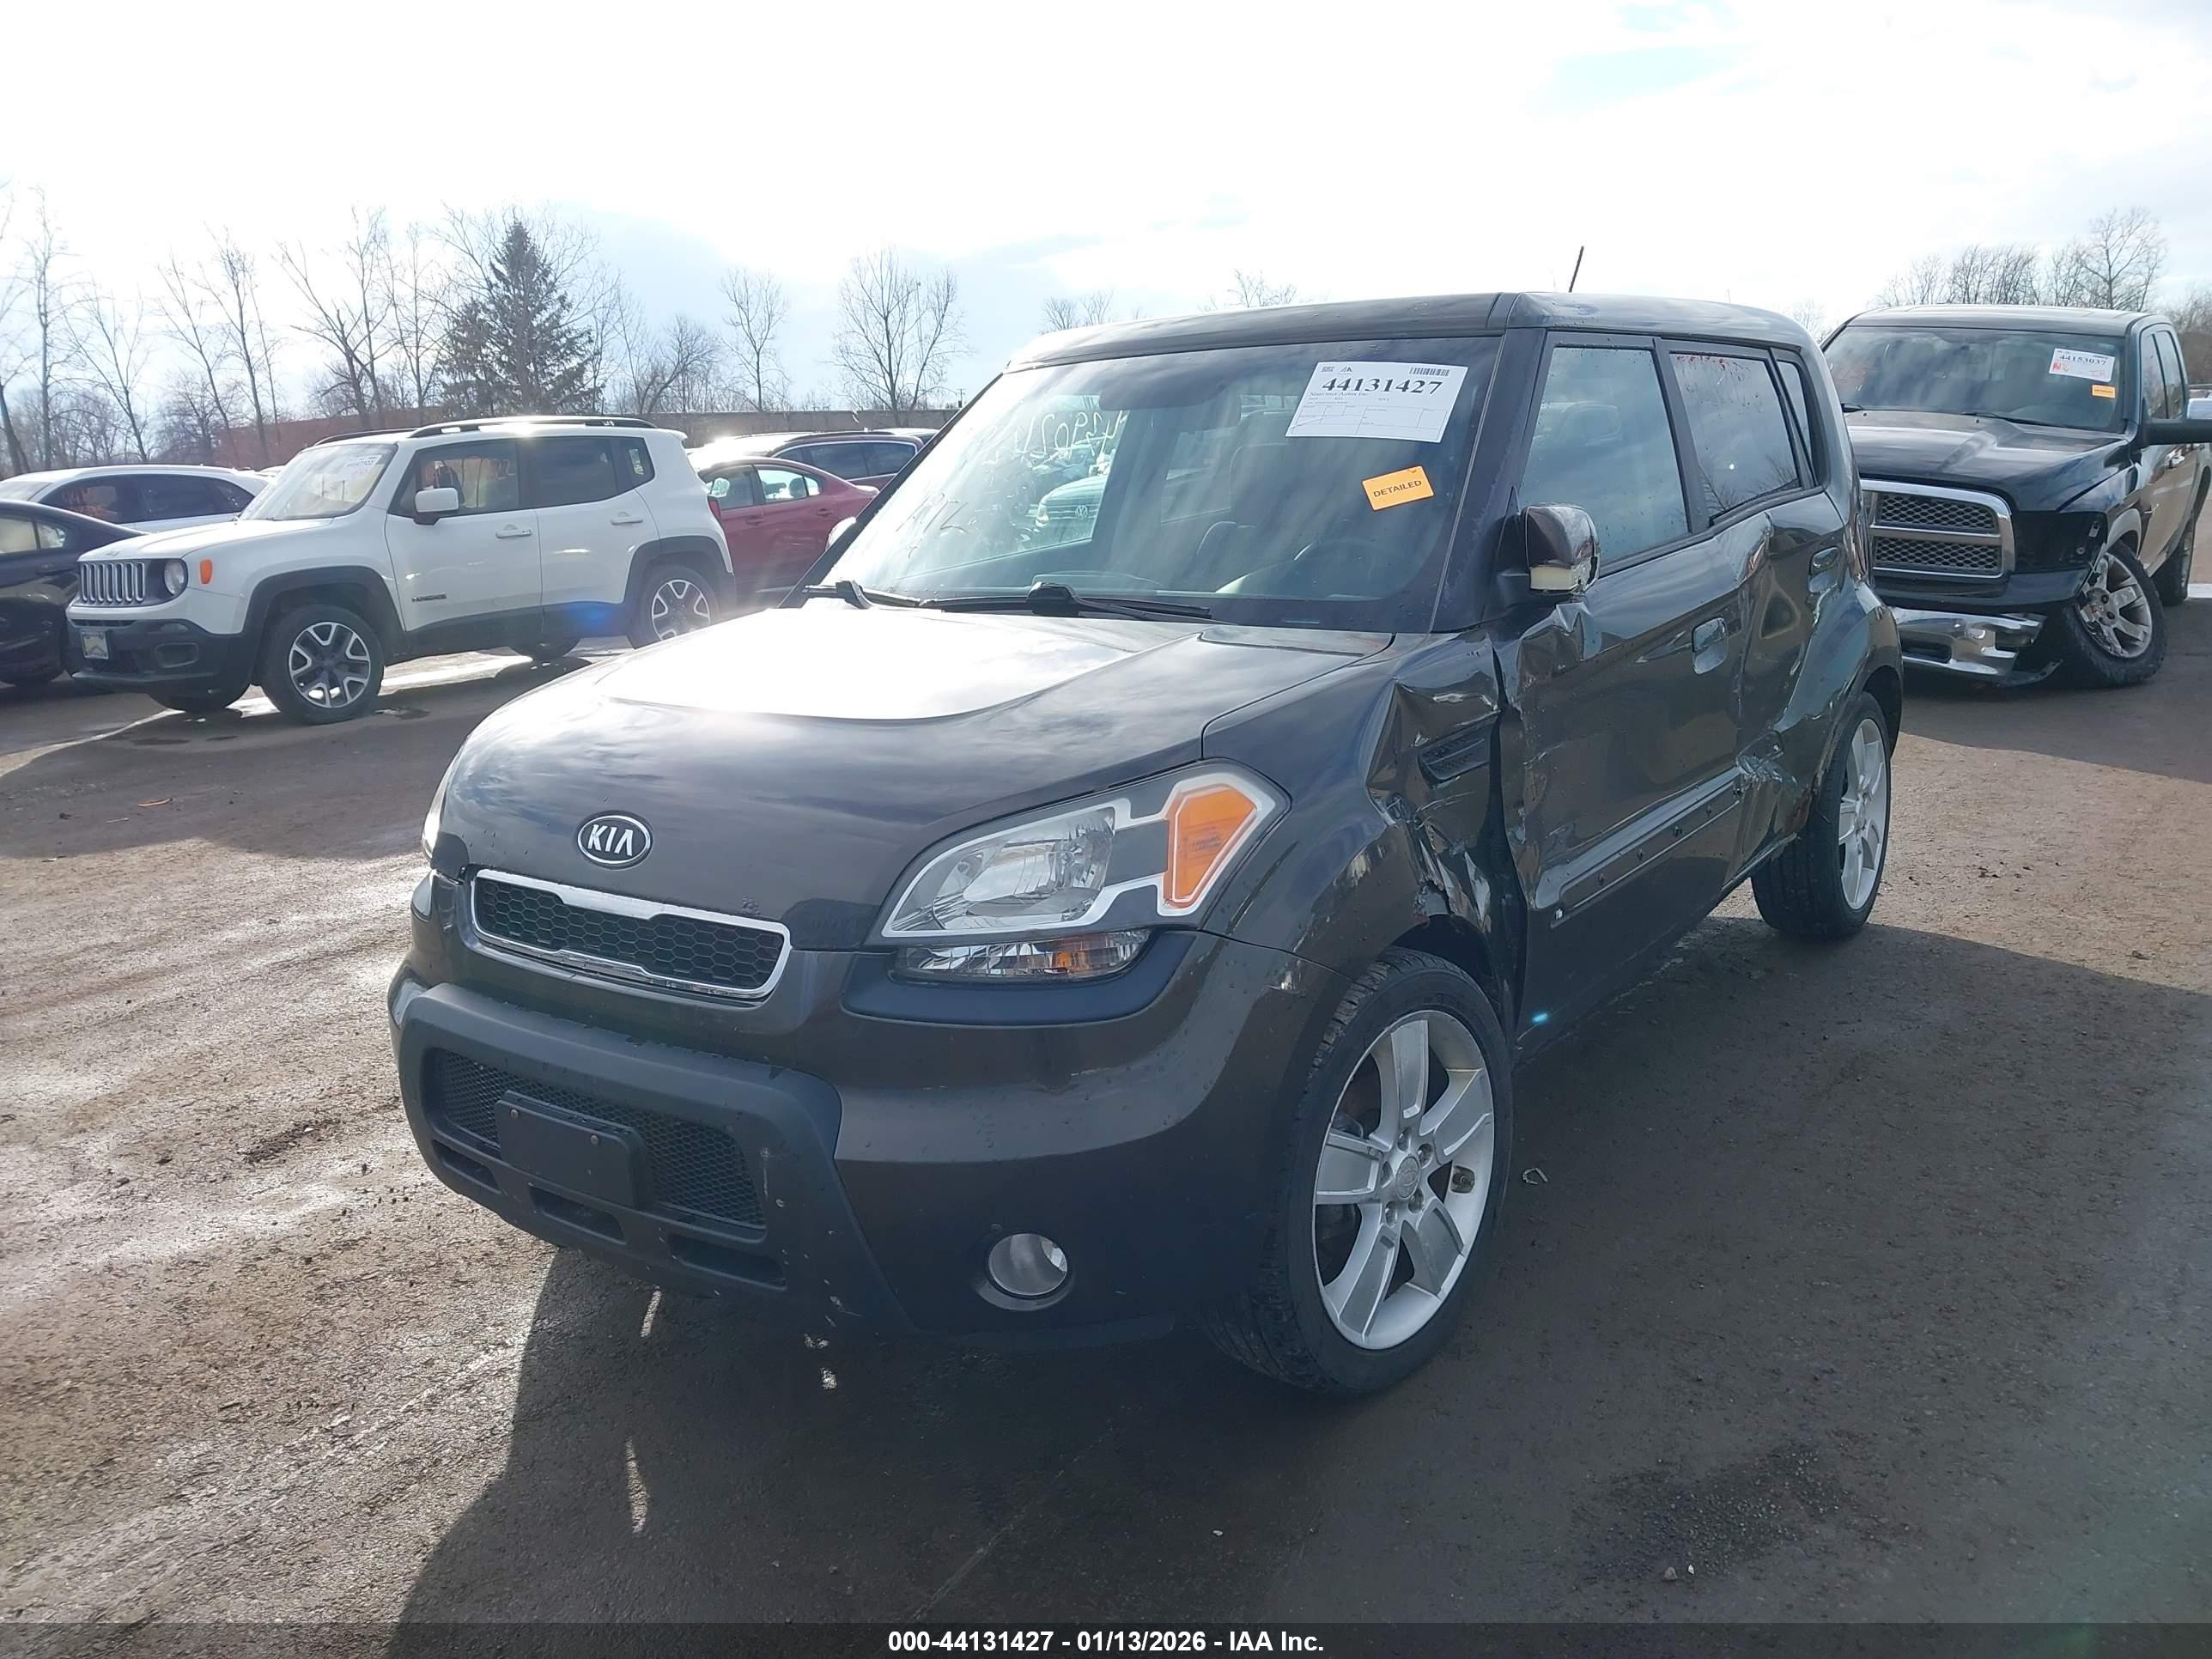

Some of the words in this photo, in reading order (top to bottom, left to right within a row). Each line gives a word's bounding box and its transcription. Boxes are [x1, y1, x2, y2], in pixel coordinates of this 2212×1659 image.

[1322, 377, 1443, 395] 44131427
[1373, 480, 1422, 497] DETAILED
[587, 823, 634, 856] KIA
